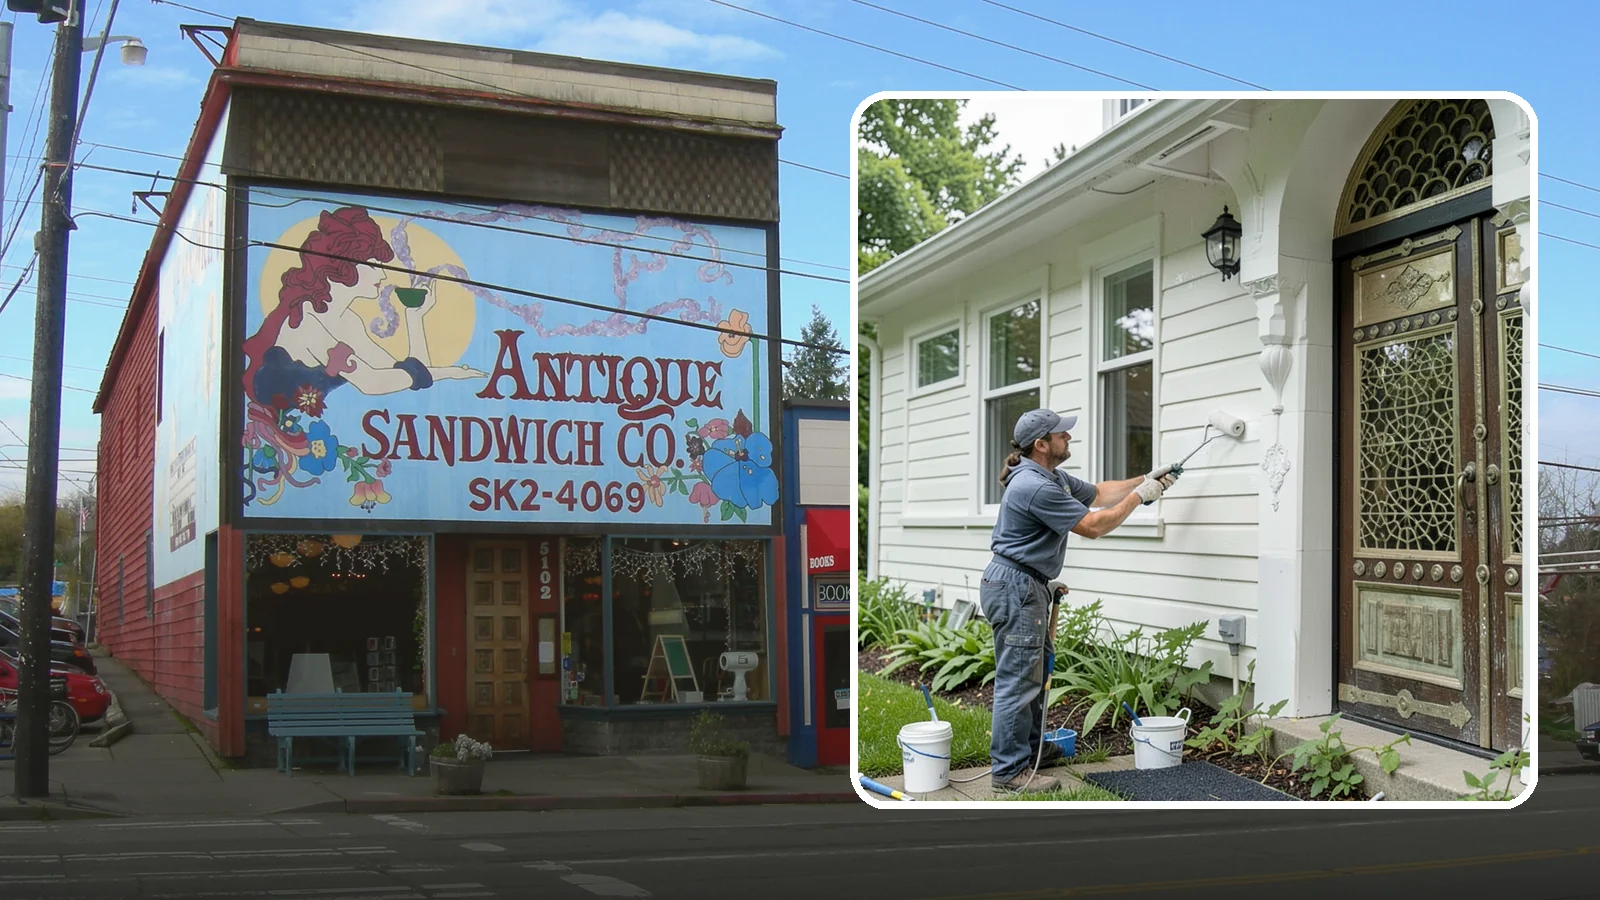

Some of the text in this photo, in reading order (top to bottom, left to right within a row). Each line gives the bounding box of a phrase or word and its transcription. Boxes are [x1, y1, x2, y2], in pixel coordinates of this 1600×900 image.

[475, 329, 724, 421] ANTIQUE
[361, 408, 685, 468] SANDWICH CO.
[468, 477, 646, 513] SK2-4069
[539, 541, 552, 600] 5102
[809, 555, 835, 569] BOOKS
